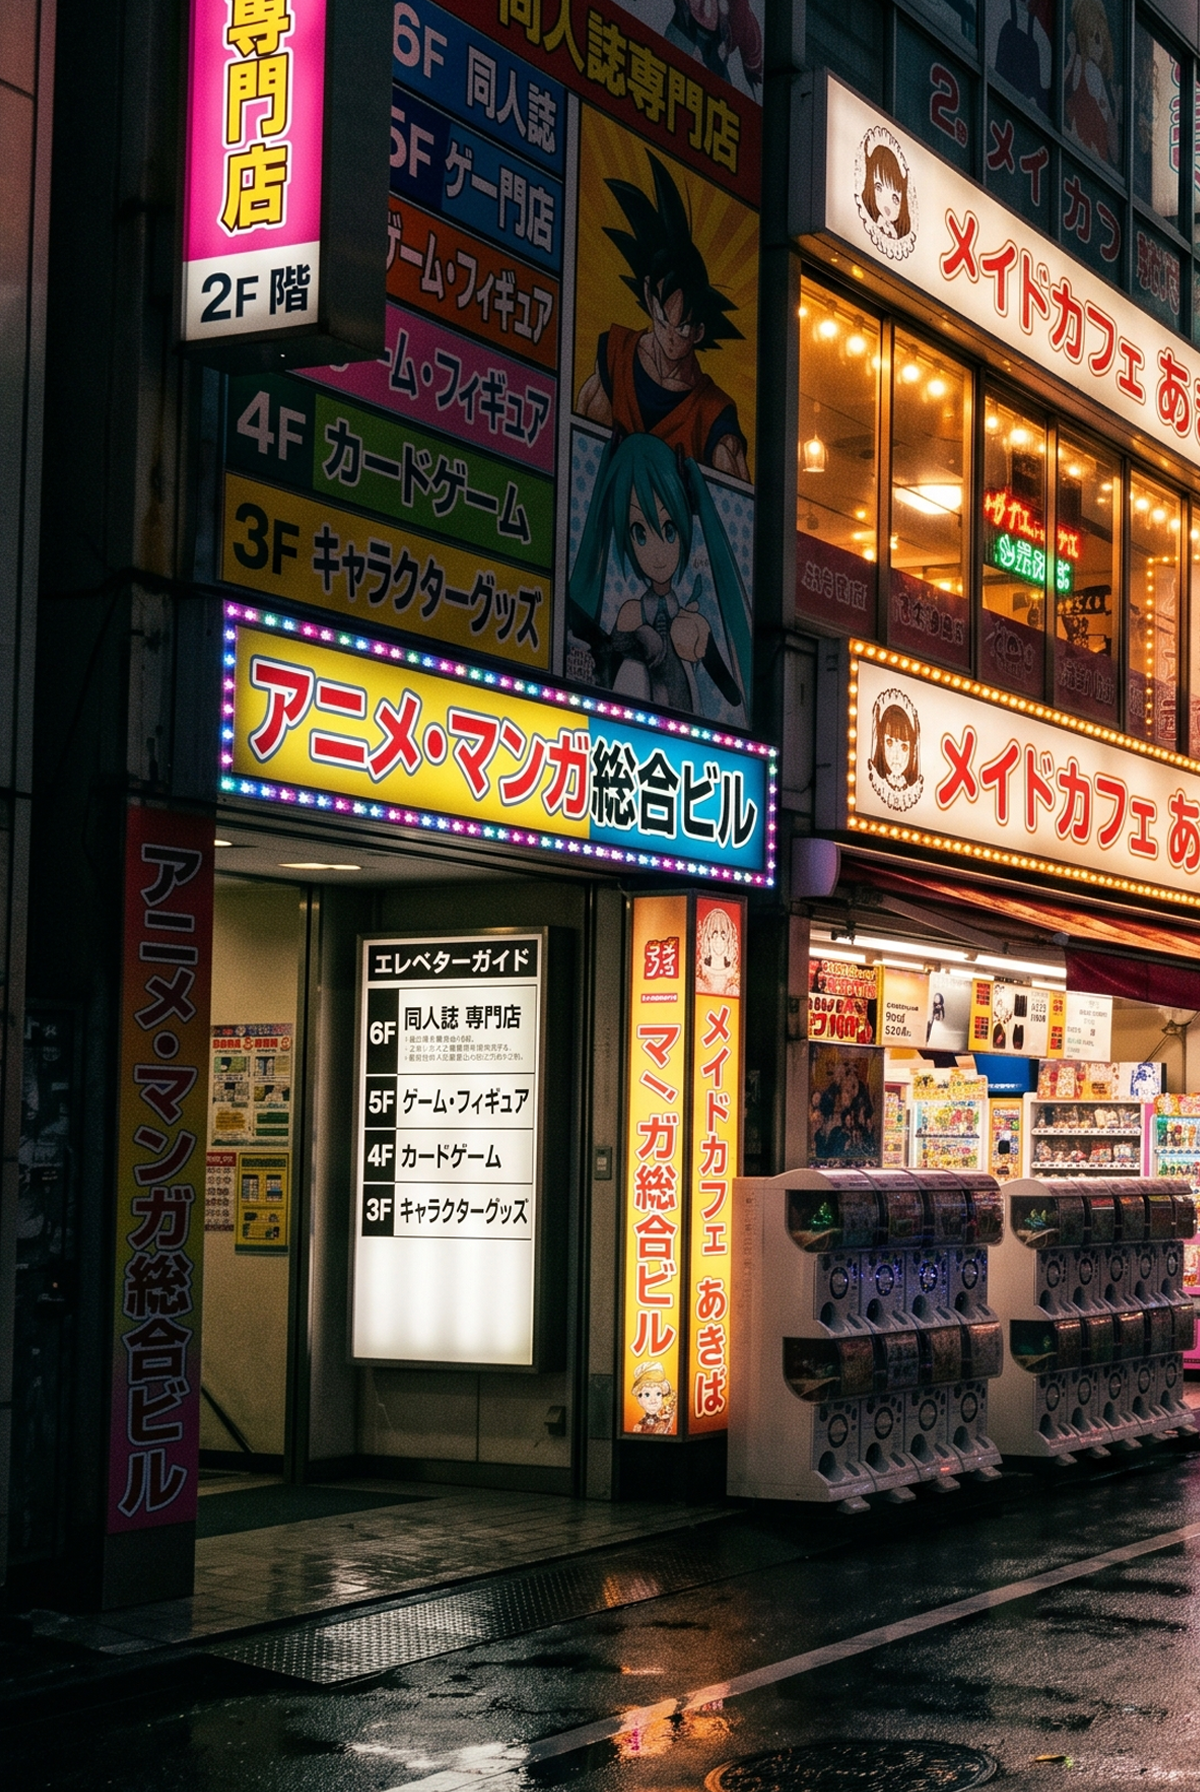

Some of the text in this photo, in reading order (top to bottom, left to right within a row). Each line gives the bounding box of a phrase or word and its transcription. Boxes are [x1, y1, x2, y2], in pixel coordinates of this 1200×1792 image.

[221, 0, 290, 232] 専門店
[393, 2, 556, 153] 6F 同人誌
[499, 0, 740, 174] 同人誌専門店
[445, 141, 554, 253] ゲー門店
[201, 264, 311, 323] 2F 階
[939, 208, 1146, 404] メイドカフェ
[237, 390, 532, 545] 4F カードゲーム
[233, 502, 542, 652] 3F キャラクターグッズ
[249, 655, 758, 849] アニメ・マンガ総合ビル
[936, 725, 1158, 860] メイドカフェ
[369, 1004, 522, 1045] 6F 同人誌 専門店
[374, 948, 530, 975] エレベターガイド
[367, 1087, 530, 1116] 5F ゲーム・フィギュア
[367, 1143, 502, 1170] 4F カードゲーム
[117, 842, 202, 1517] アニメ・マンガ総合ビル
[366, 1197, 529, 1226] 3F キャラクターグッズ
[694, 1004, 731, 1419] メイドカフェ あきば
